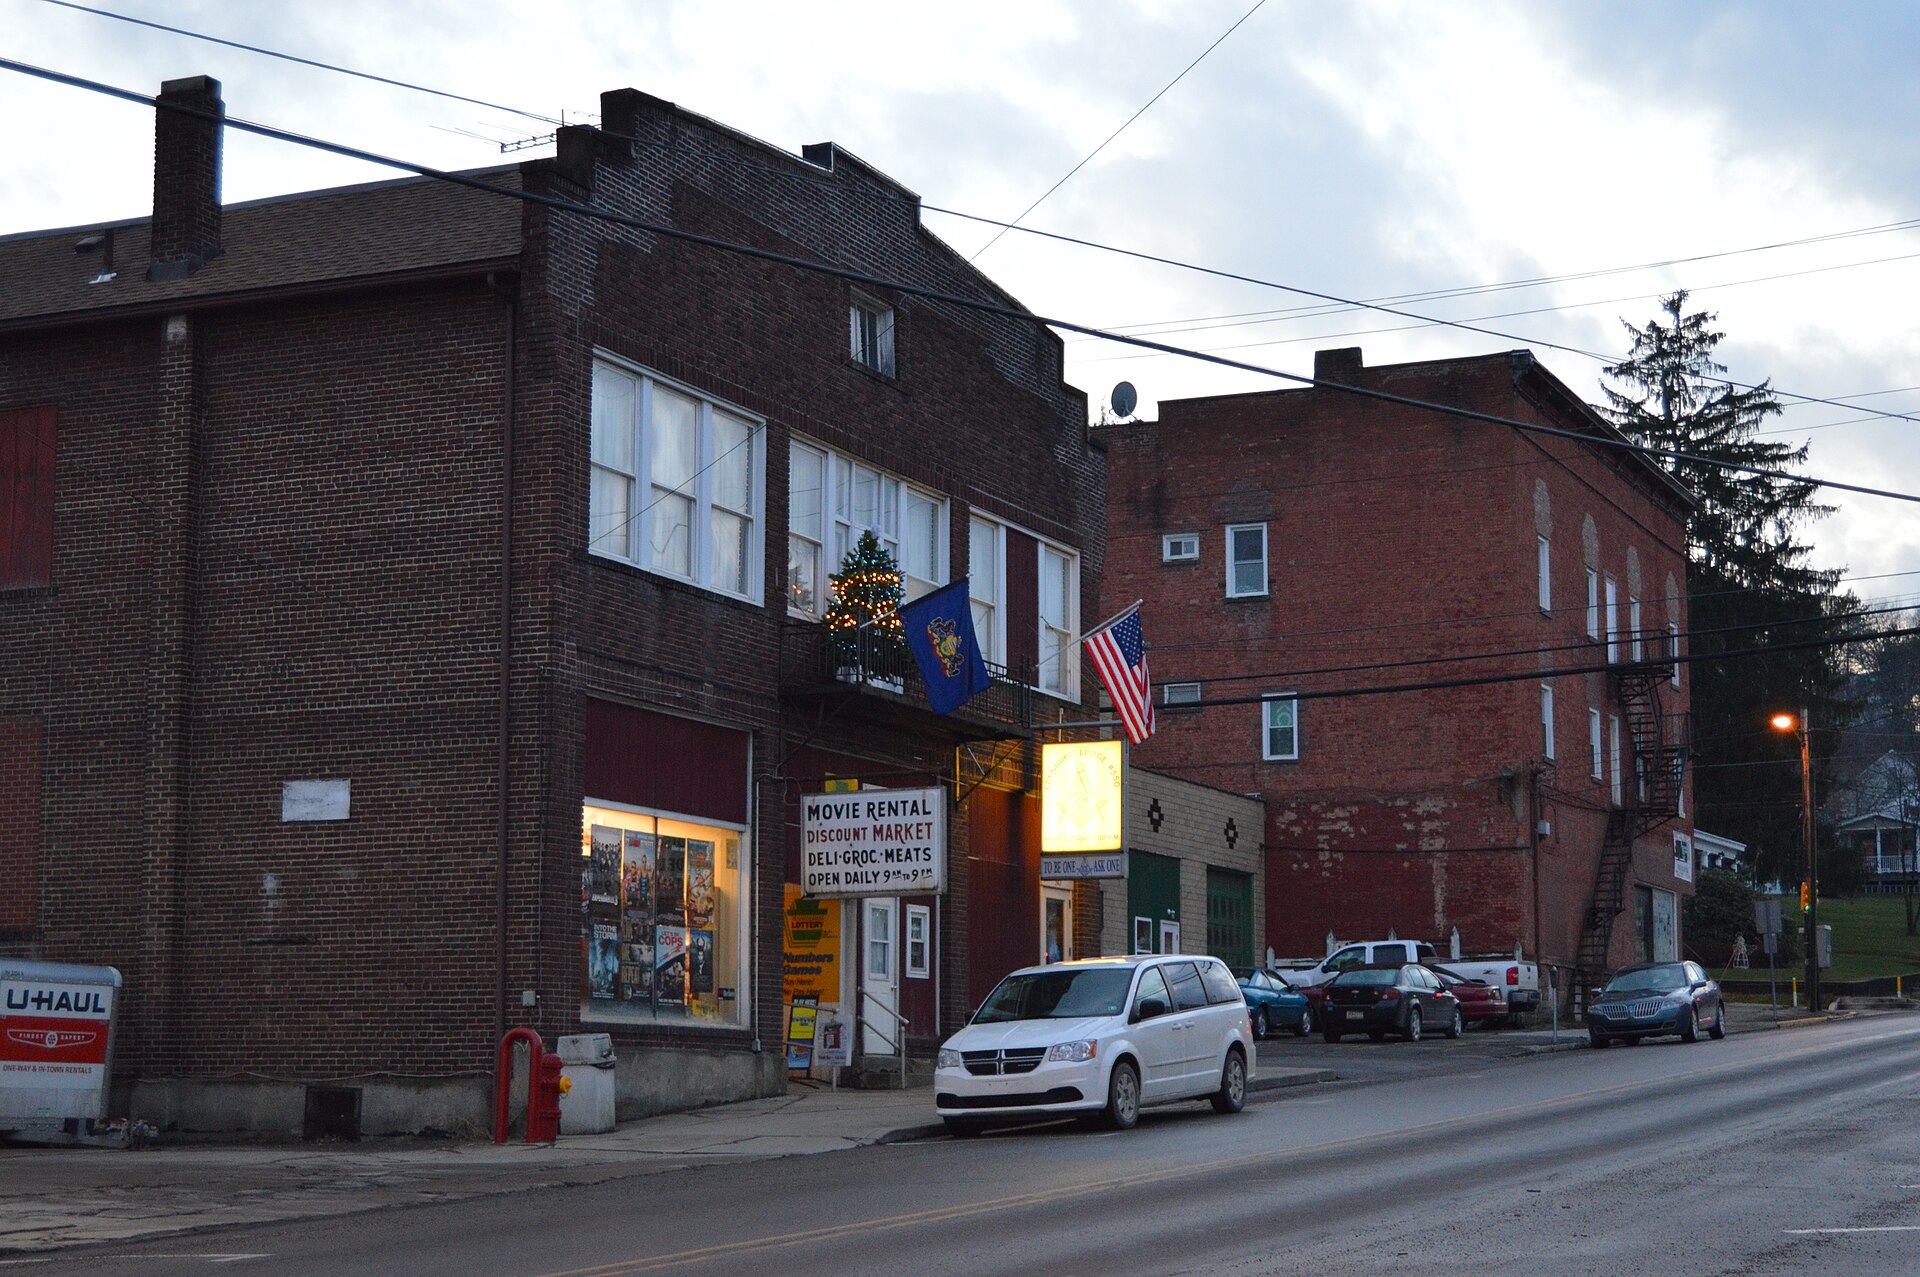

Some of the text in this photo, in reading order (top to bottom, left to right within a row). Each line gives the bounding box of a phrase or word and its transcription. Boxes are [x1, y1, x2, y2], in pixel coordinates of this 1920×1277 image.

[1080, 748, 1106, 763] LODGE
[808, 799, 932, 821] MOVIE RENTAL
[806, 822, 933, 844] DISCOUNT MARKET
[1044, 859, 1120, 874] TO BE ONE ASK ONE
[809, 872, 840, 886] OPEN
[845, 870, 880, 884] DAILY
[594, 930, 618, 941] STORM
[658, 935, 683, 946] COPS
[784, 952, 833, 962] Numbers
[784, 964, 822, 974] Games
[7, 989, 106, 1013] U-HAUL
